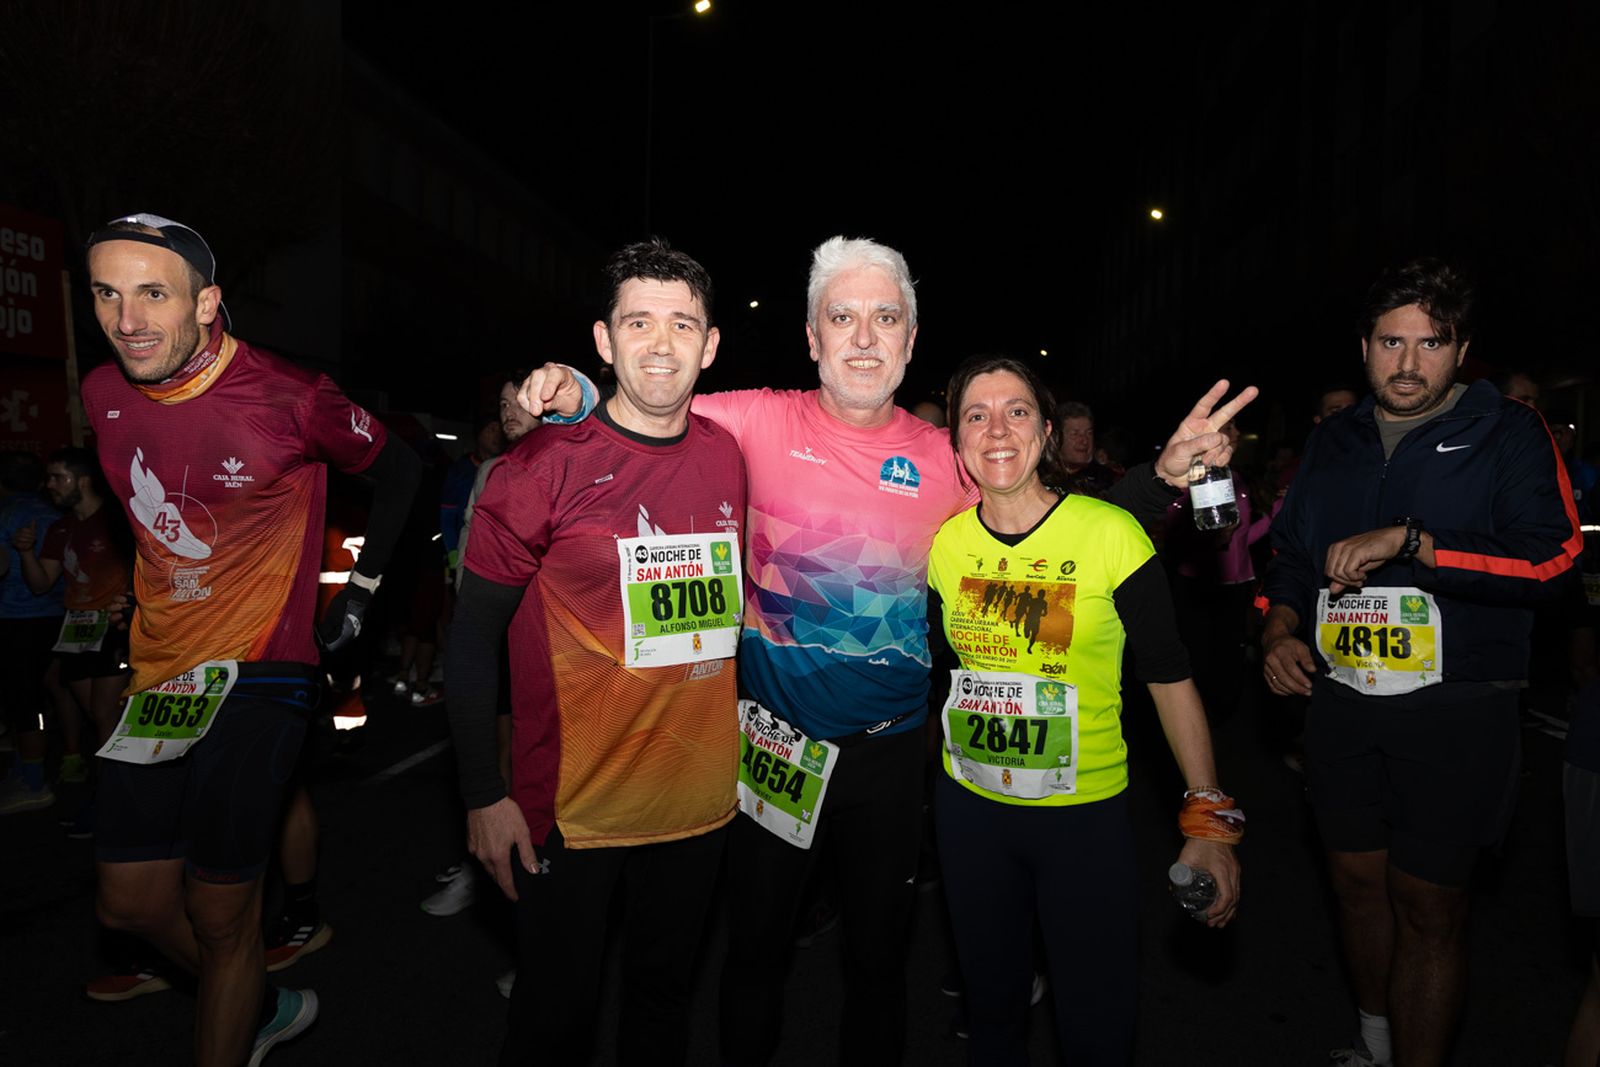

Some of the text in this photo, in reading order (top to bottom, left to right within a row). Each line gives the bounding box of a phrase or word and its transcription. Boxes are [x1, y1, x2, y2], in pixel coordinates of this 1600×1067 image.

[153, 512, 181, 543] 43
[651, 549, 686, 563] NOCHE
[688, 549, 701, 560] DE
[636, 566, 661, 582] SAN
[665, 562, 703, 579] ANTÓN
[175, 579, 199, 589] SAN
[651, 578, 726, 622] 8708
[1338, 600, 1387, 609] NOCHE DE
[1327, 610, 1388, 624] SAN ANTÓN
[660, 618, 725, 633] ALFONSO MIGUEL
[950, 630, 1009, 644] NOCHE DE
[1336, 626, 1411, 659] 4813
[975, 644, 1017, 657] ANTÓN
[183, 672, 195, 681] DE
[1008, 687, 1022, 698] DE
[138, 694, 209, 728] 9633
[958, 699, 1022, 715] SAN ANTÓN
[753, 718, 794, 746] NOCHE DE
[967, 715, 1048, 754] 2847
[756, 736, 792, 759] ANTÓN
[988, 755, 1025, 766] VICTORIA
